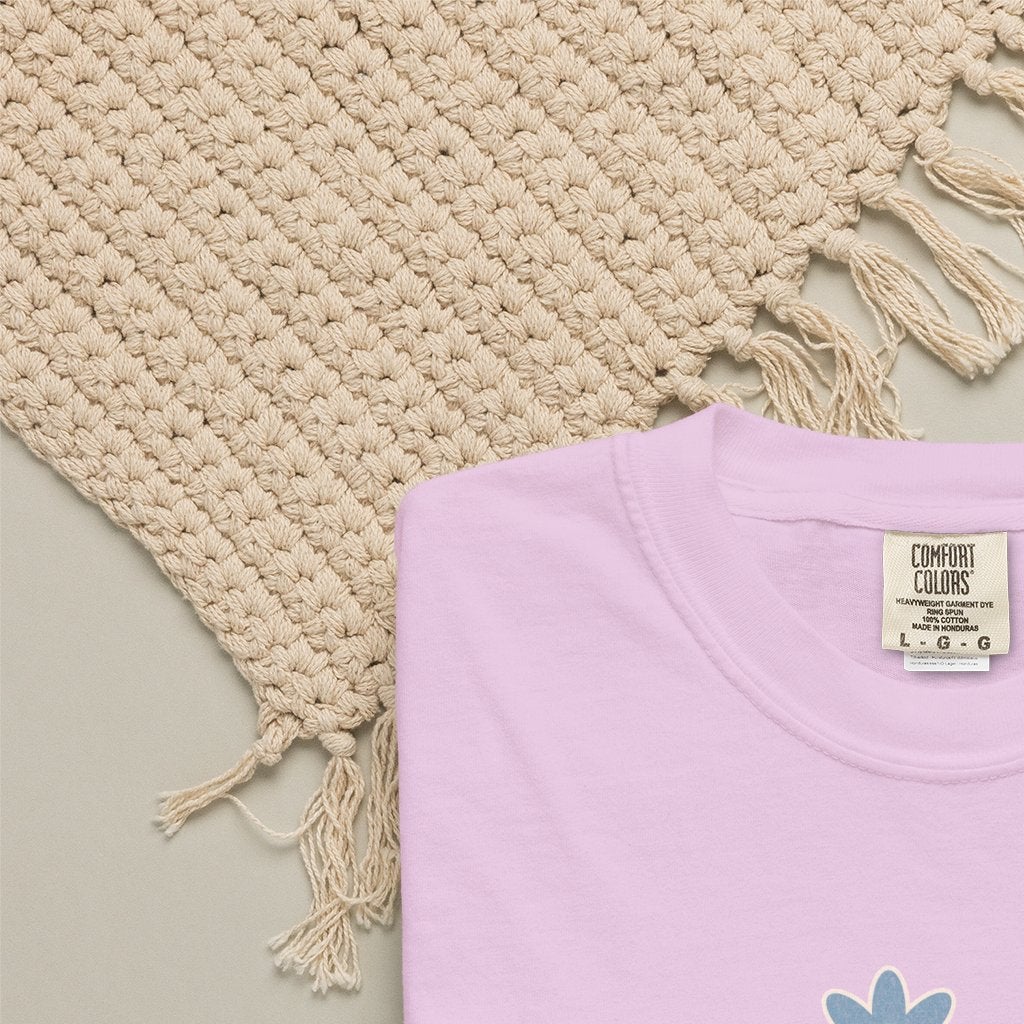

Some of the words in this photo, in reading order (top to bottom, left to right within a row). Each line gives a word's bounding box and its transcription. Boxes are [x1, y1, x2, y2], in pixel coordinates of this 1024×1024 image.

[911, 543, 975, 568] COMFORT
[896, 598, 944, 608] HEAVYWEIGHT
[912, 623, 932, 631] MADE
[900, 632, 910, 648] L
[937, 635, 950, 650] G
[977, 636, 991, 650] G
